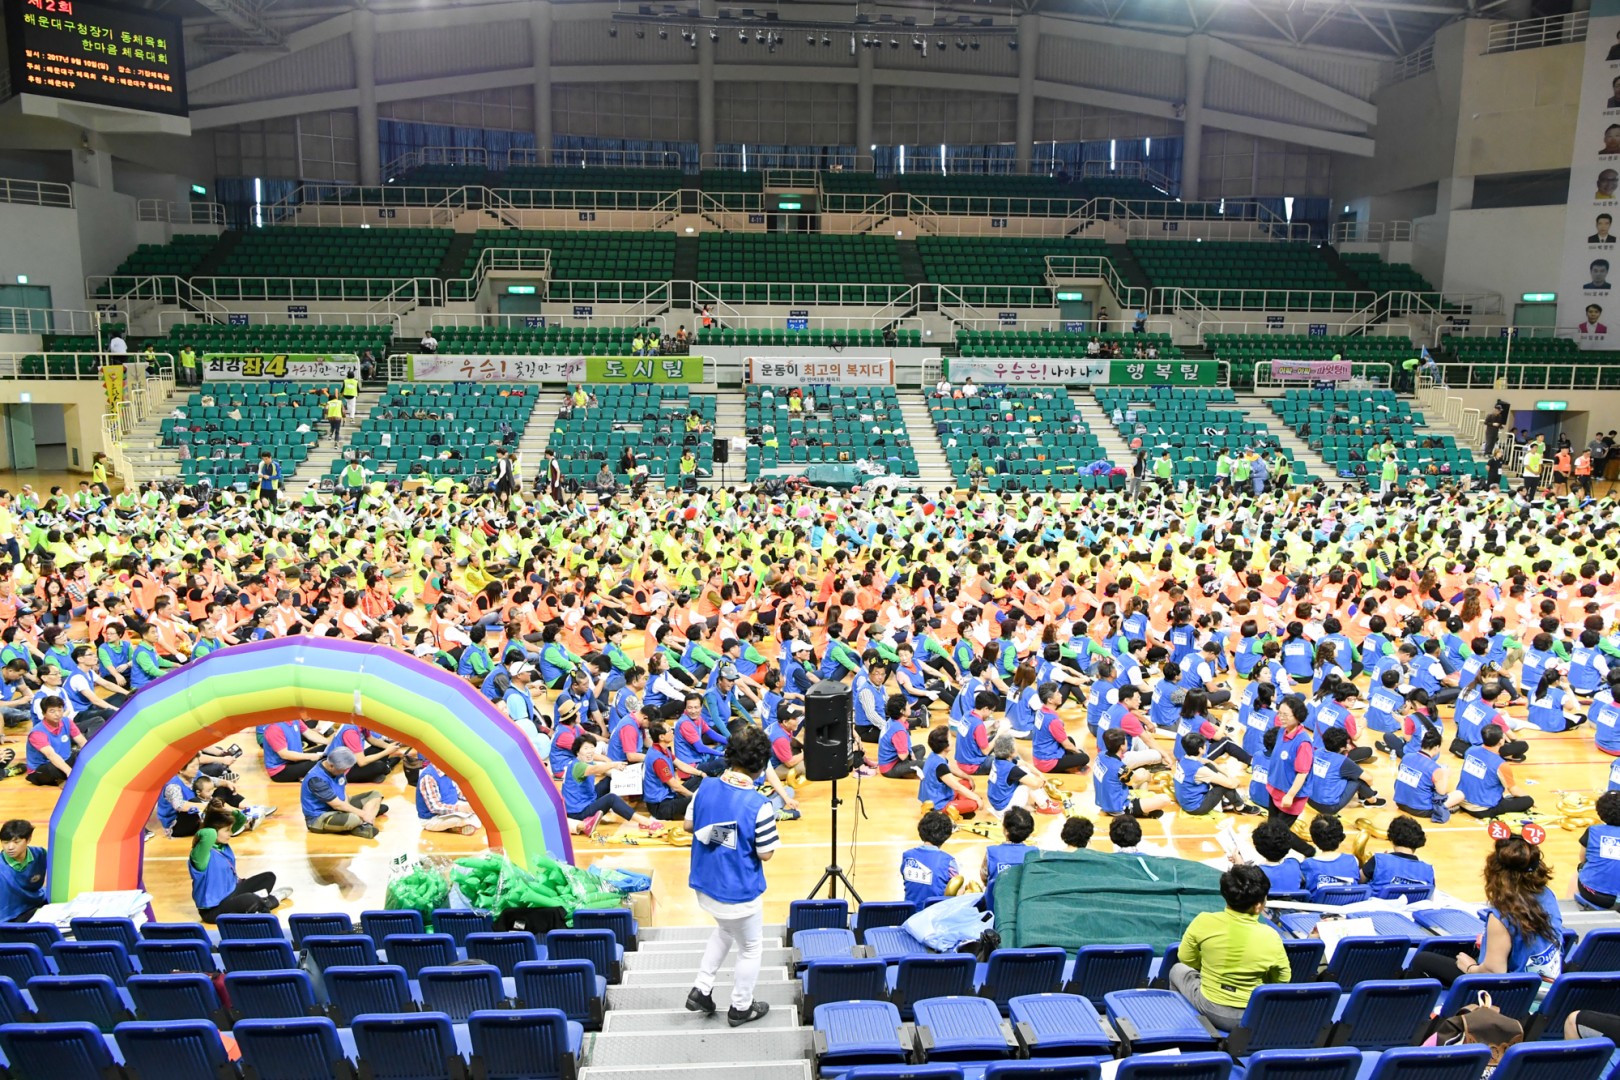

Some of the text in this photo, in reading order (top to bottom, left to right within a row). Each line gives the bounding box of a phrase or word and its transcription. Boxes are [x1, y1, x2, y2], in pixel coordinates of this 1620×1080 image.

[27, 0, 73, 15] 제2회
[24, 13, 167, 50] 해운대구청장기 동체육회
[47, 53, 69, 64] 2017년
[82, 39, 168, 64] 한마음 체육대회
[209, 356, 240, 372] 최강
[459, 358, 683, 378] 우승! 꽃길만 걷자 도시팀
[761, 363, 884, 377] 운동이 최고의 복지다
[994, 361, 1047, 381] 우승은!
[1126, 363, 1199, 380] 행복팀
